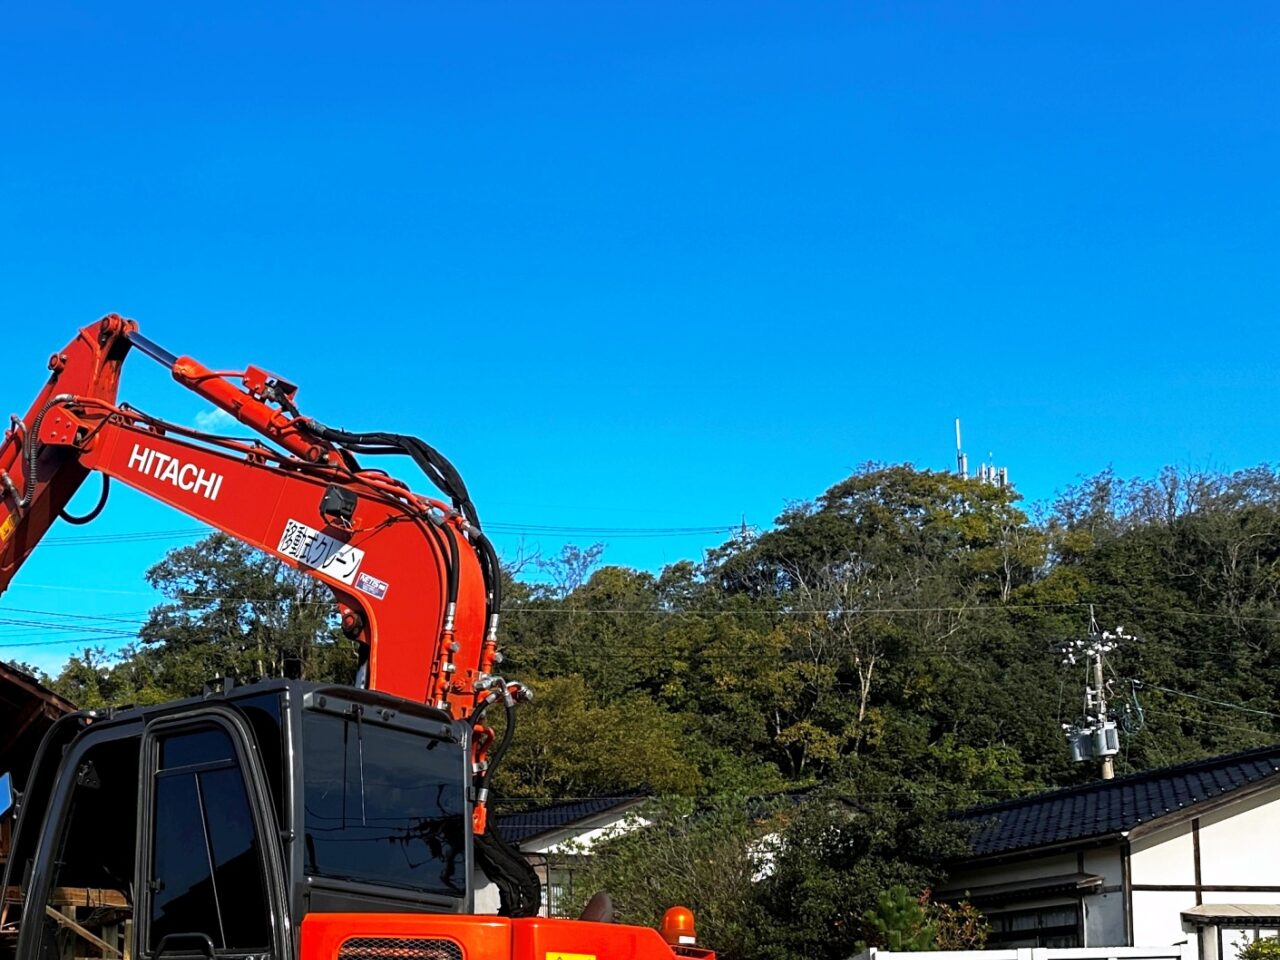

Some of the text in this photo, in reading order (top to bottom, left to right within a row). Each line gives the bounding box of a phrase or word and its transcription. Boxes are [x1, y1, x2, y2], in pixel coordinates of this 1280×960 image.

[128, 443, 224, 501] HITACHI
[280, 521, 360, 578] 移動式クレーン
